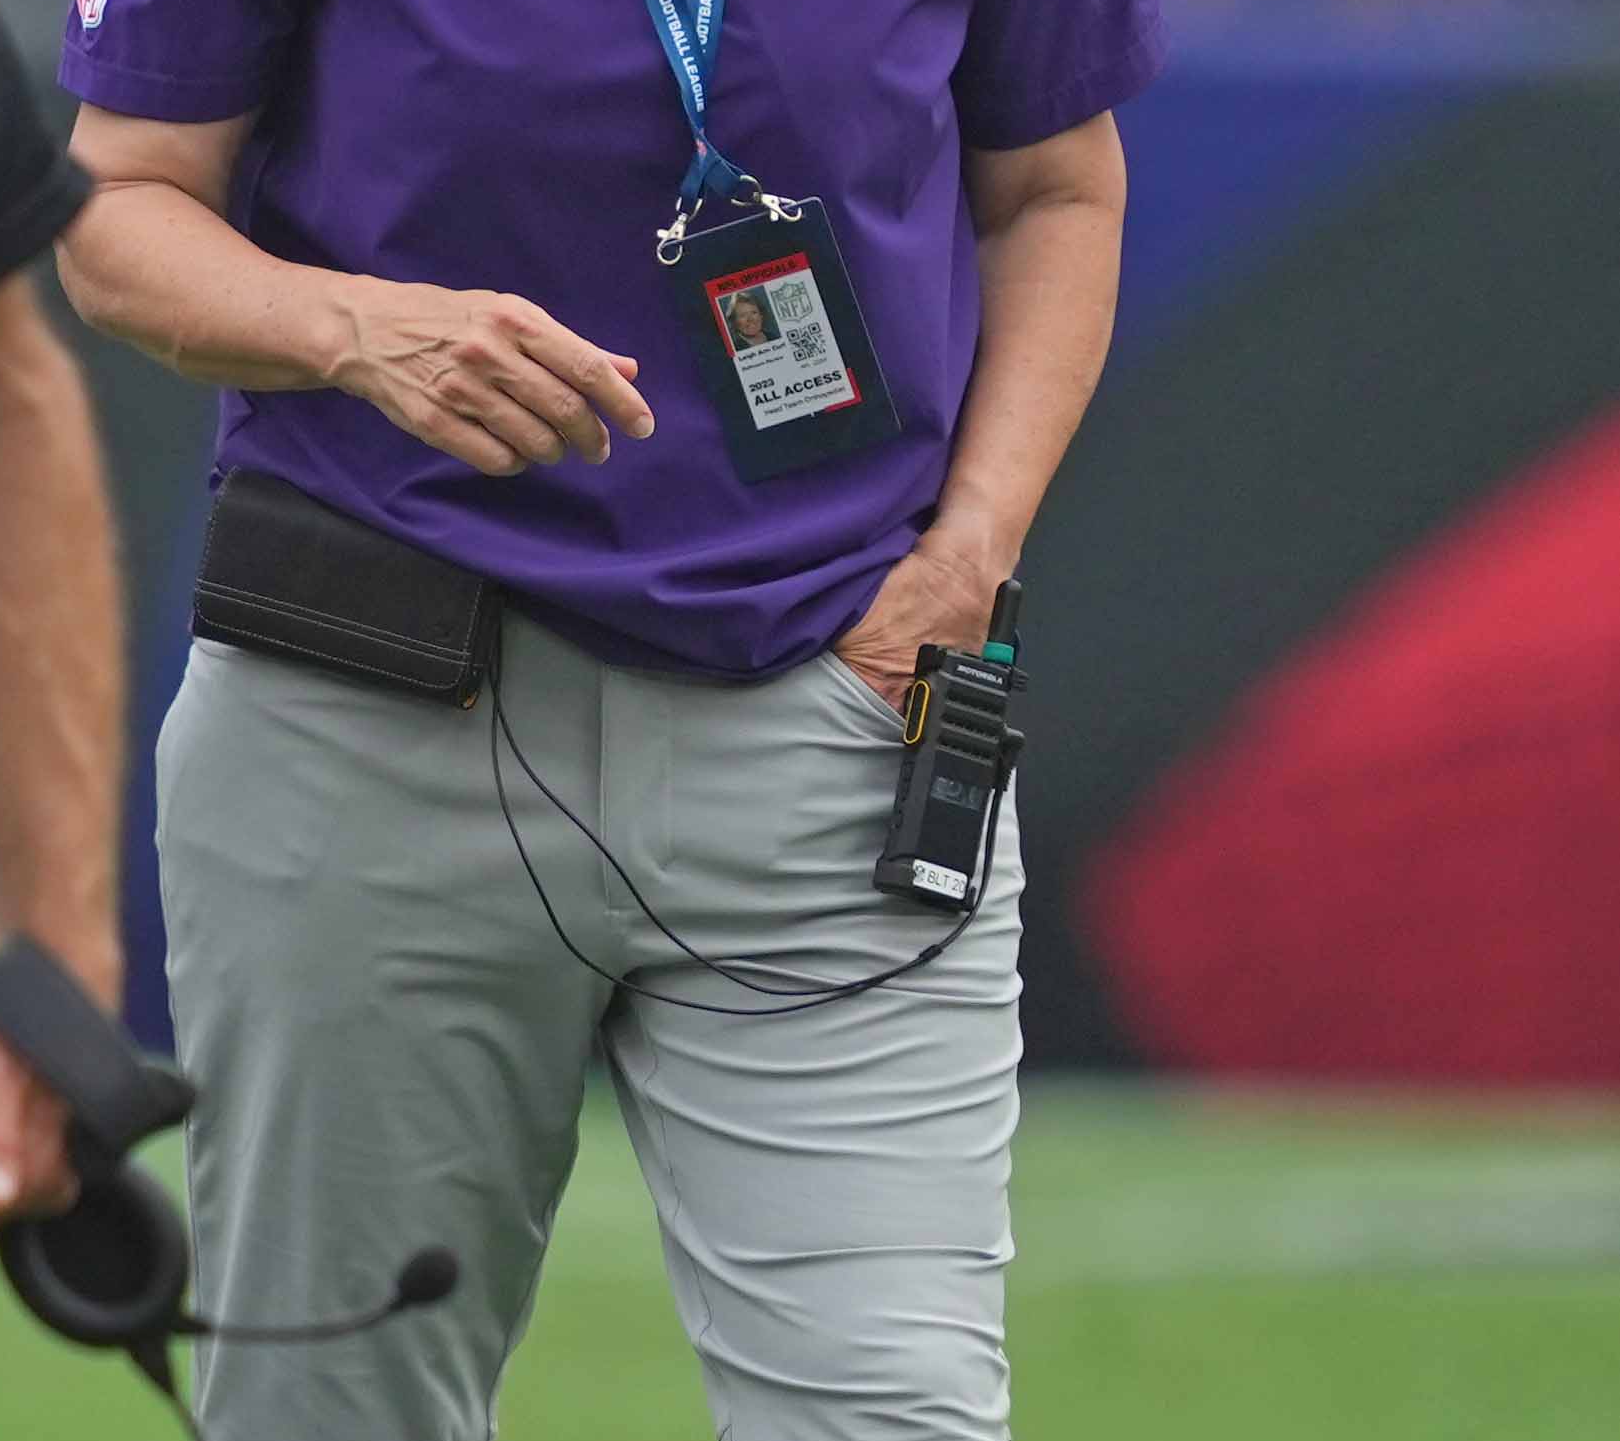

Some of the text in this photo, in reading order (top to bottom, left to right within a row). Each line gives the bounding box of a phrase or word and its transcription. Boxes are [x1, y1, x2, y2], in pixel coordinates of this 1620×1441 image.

[682, 56, 706, 112] LEAGUE
[778, 296, 812, 319] NFL
[748, 377, 775, 393] 2023
[754, 370, 843, 407] ALL ACCESS
[956, 664, 1004, 685] MOTOROLA
